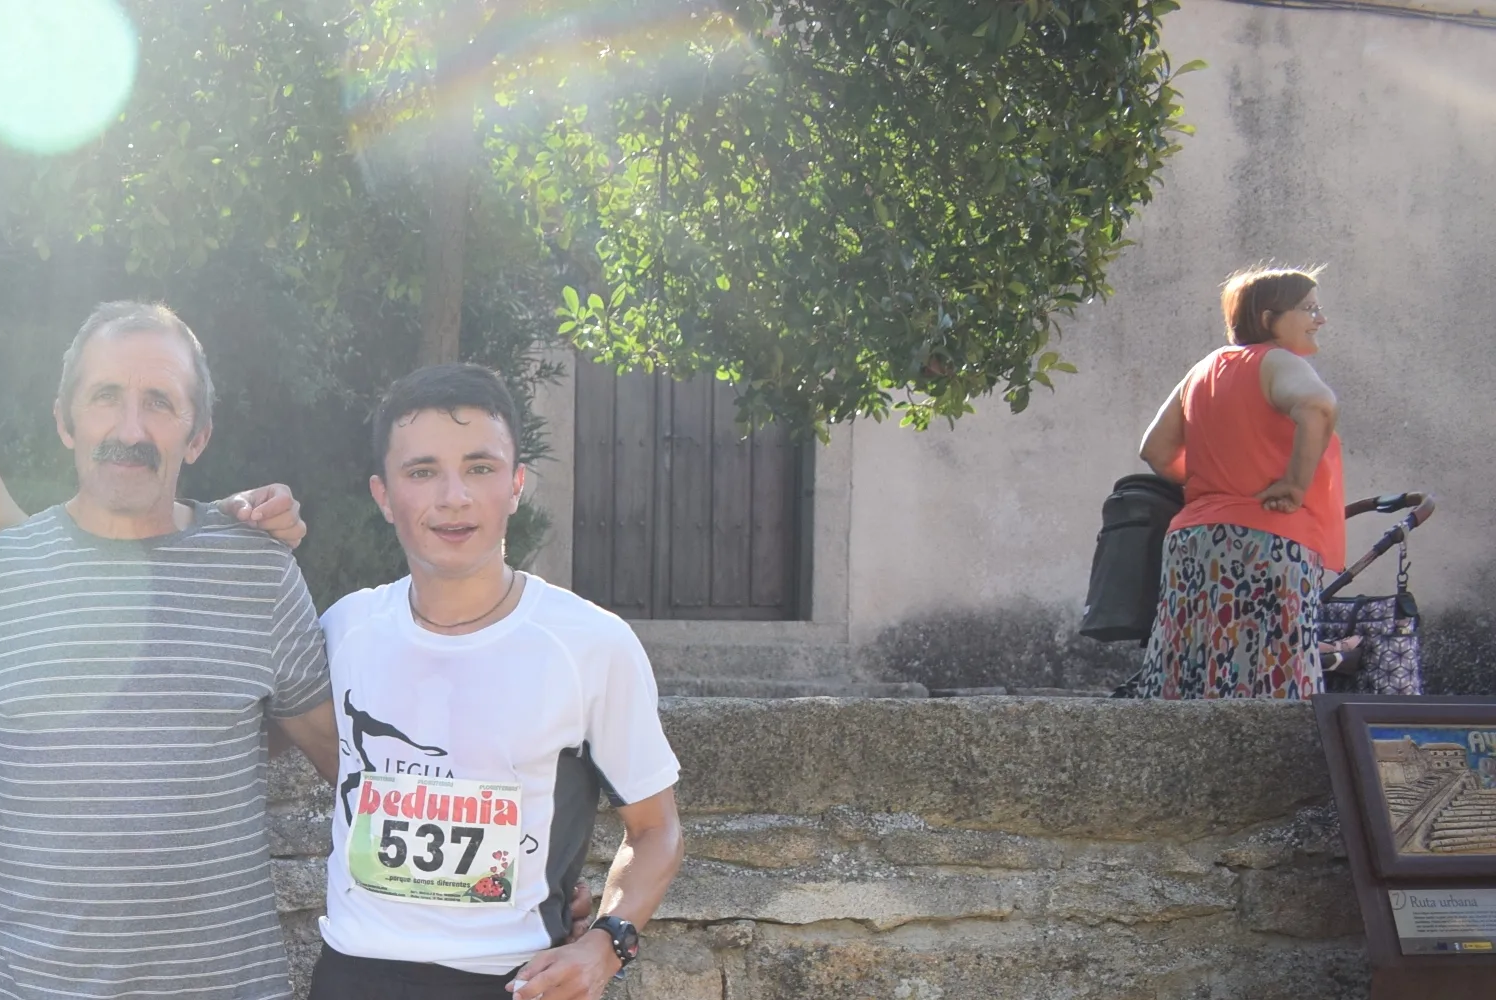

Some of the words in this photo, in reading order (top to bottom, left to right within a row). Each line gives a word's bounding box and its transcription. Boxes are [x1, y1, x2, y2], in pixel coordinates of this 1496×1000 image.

[357, 780, 519, 827] bedunia
[377, 819, 485, 876] 537
[413, 877, 435, 886] somos
[436, 880, 471, 889] diferentes
[1409, 895, 1437, 908] Ruta
[1439, 894, 1479, 907] urbana
